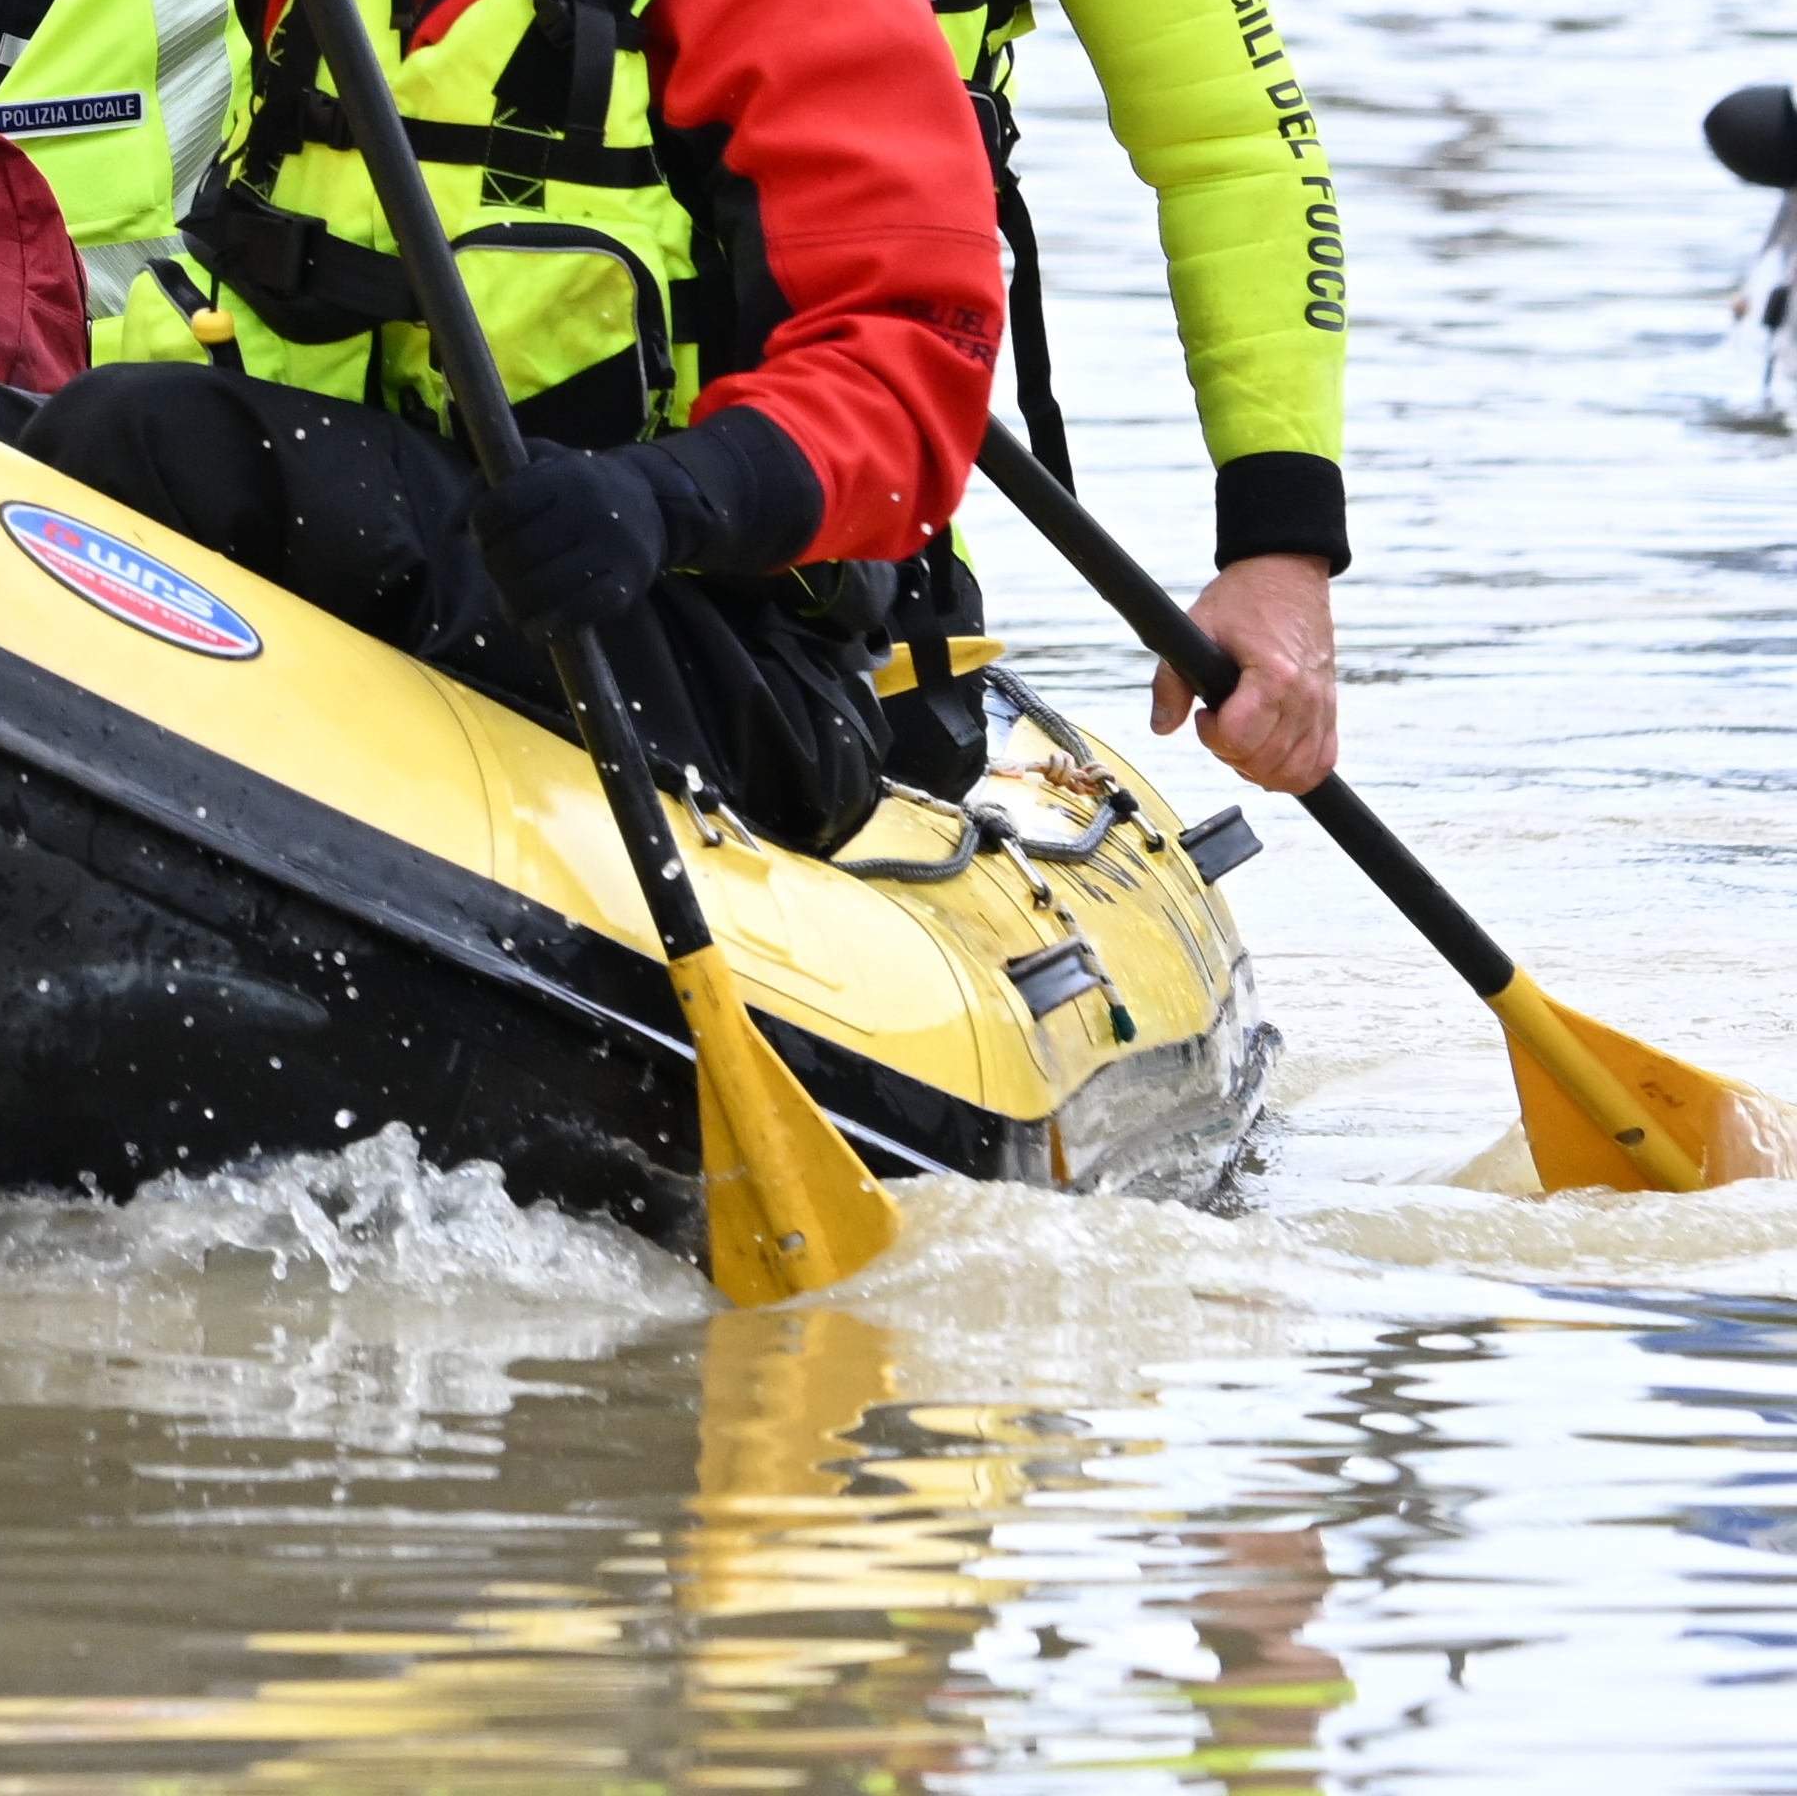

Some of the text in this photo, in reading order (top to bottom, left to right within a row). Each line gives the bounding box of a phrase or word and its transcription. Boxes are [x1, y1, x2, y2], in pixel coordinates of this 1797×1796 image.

[1, 98, 136, 128] POLIZIA LOCALE
[1265, 78, 1319, 160] DEL
[1301, 176, 1347, 333] FUOCO
[45, 552, 219, 643] WATER RESCUE SYSTEM
